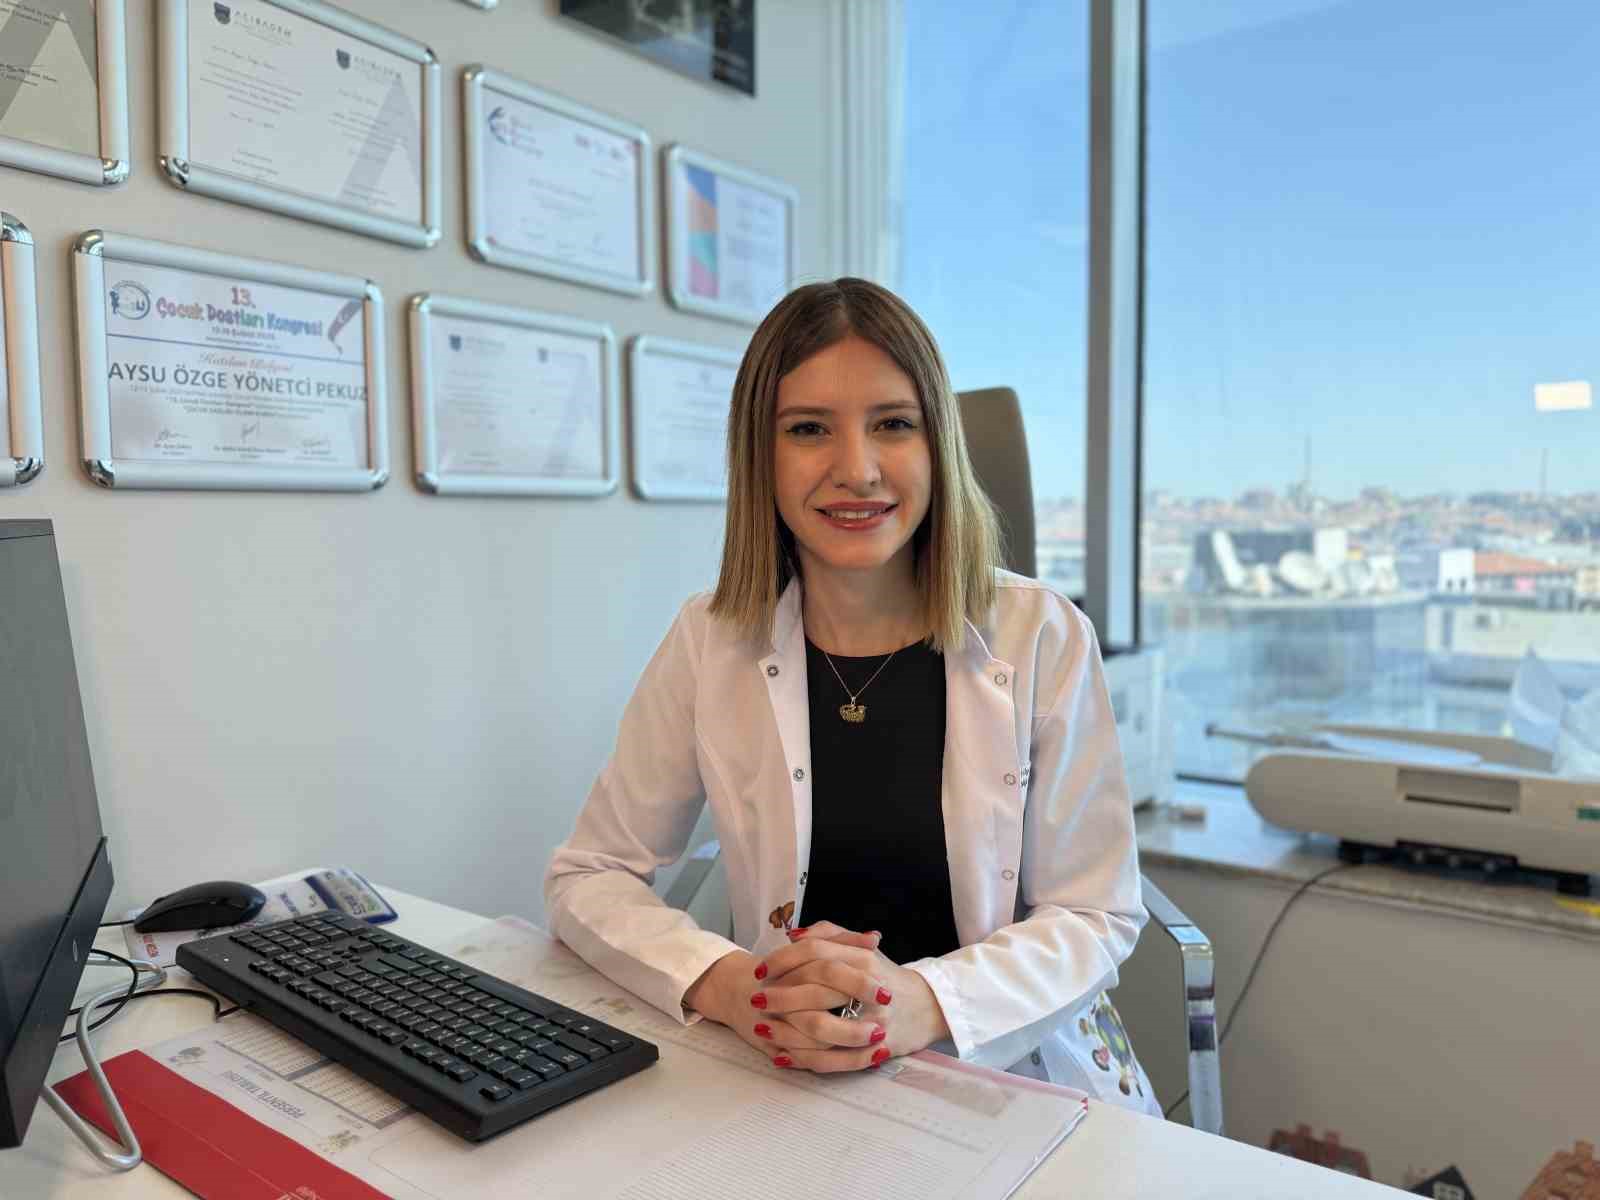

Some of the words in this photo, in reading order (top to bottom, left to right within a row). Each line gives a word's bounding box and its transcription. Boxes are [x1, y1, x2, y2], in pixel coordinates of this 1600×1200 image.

[156, 296, 204, 320] Çocuk
[231, 286, 256, 309] 13.
[107, 361, 166, 383] AYSU
[173, 364, 227, 389] ÖZGE
[233, 370, 312, 397] YÖNETCİ
